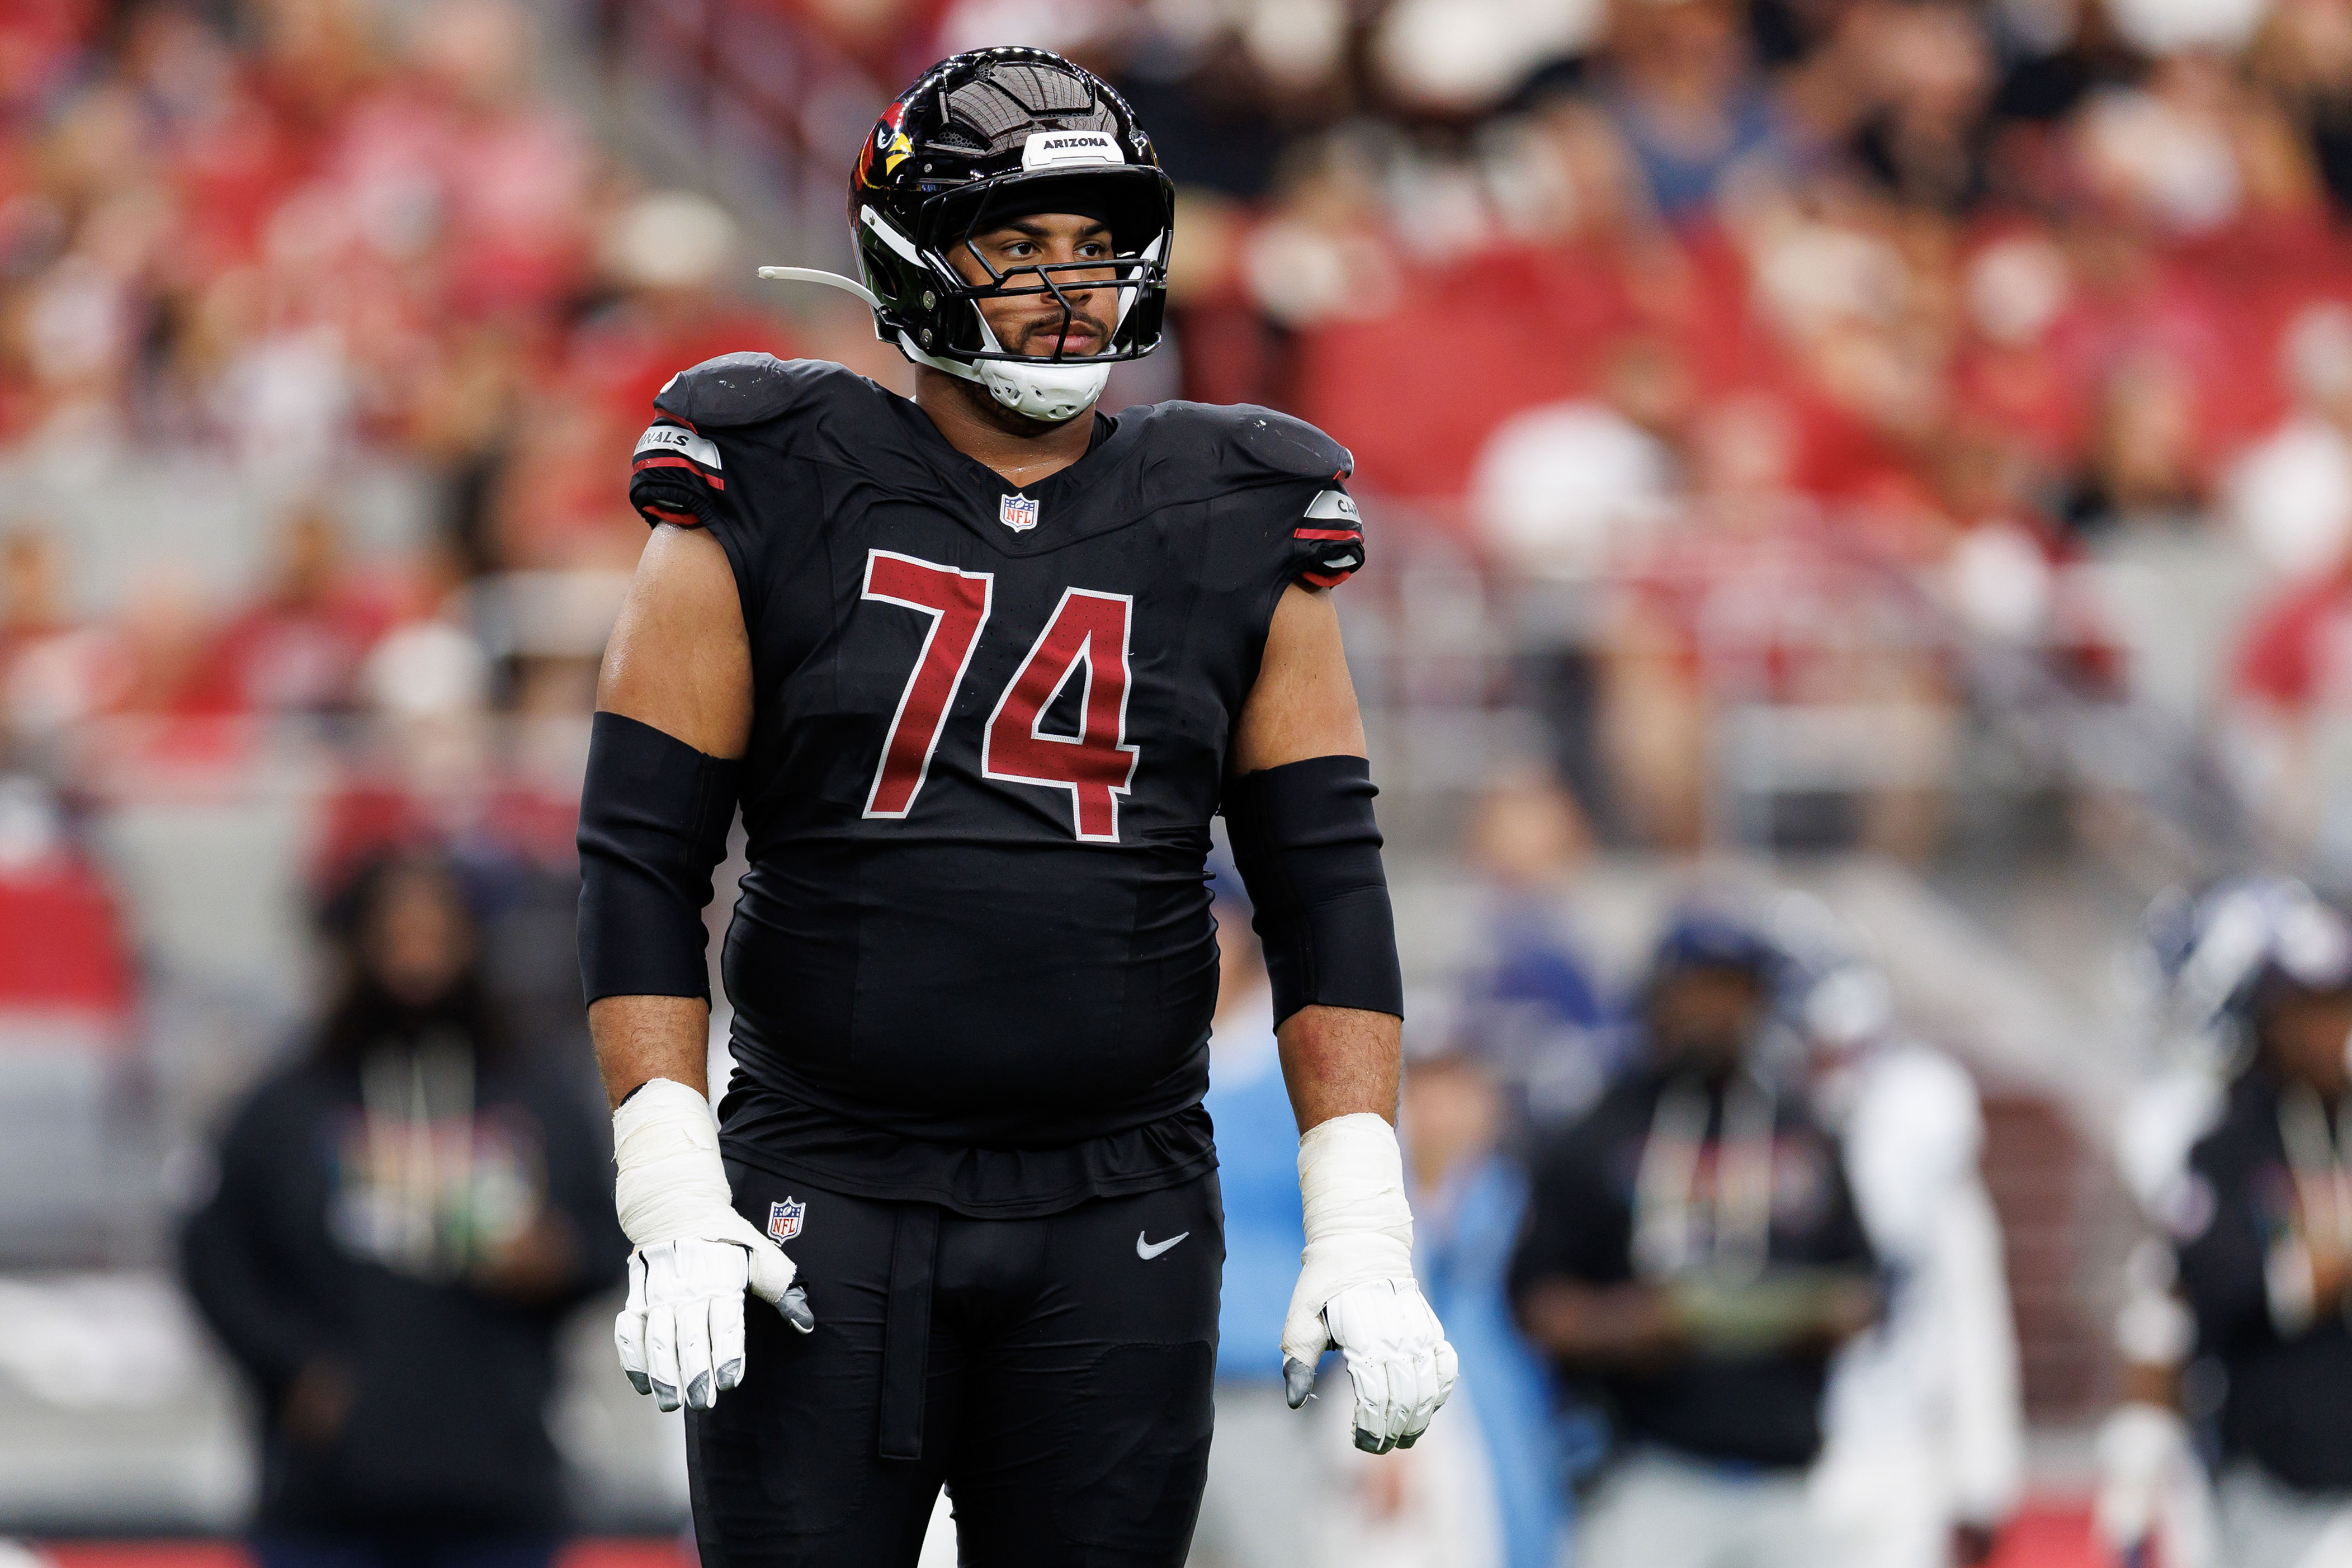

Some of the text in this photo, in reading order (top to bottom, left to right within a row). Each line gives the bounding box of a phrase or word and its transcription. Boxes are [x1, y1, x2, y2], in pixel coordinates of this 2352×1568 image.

[1043, 138, 1108, 150] ARIZONA
[1007, 508, 1031, 524] NFL
[861, 549, 1140, 843] 74
[773, 1218, 795, 1235] NFL
